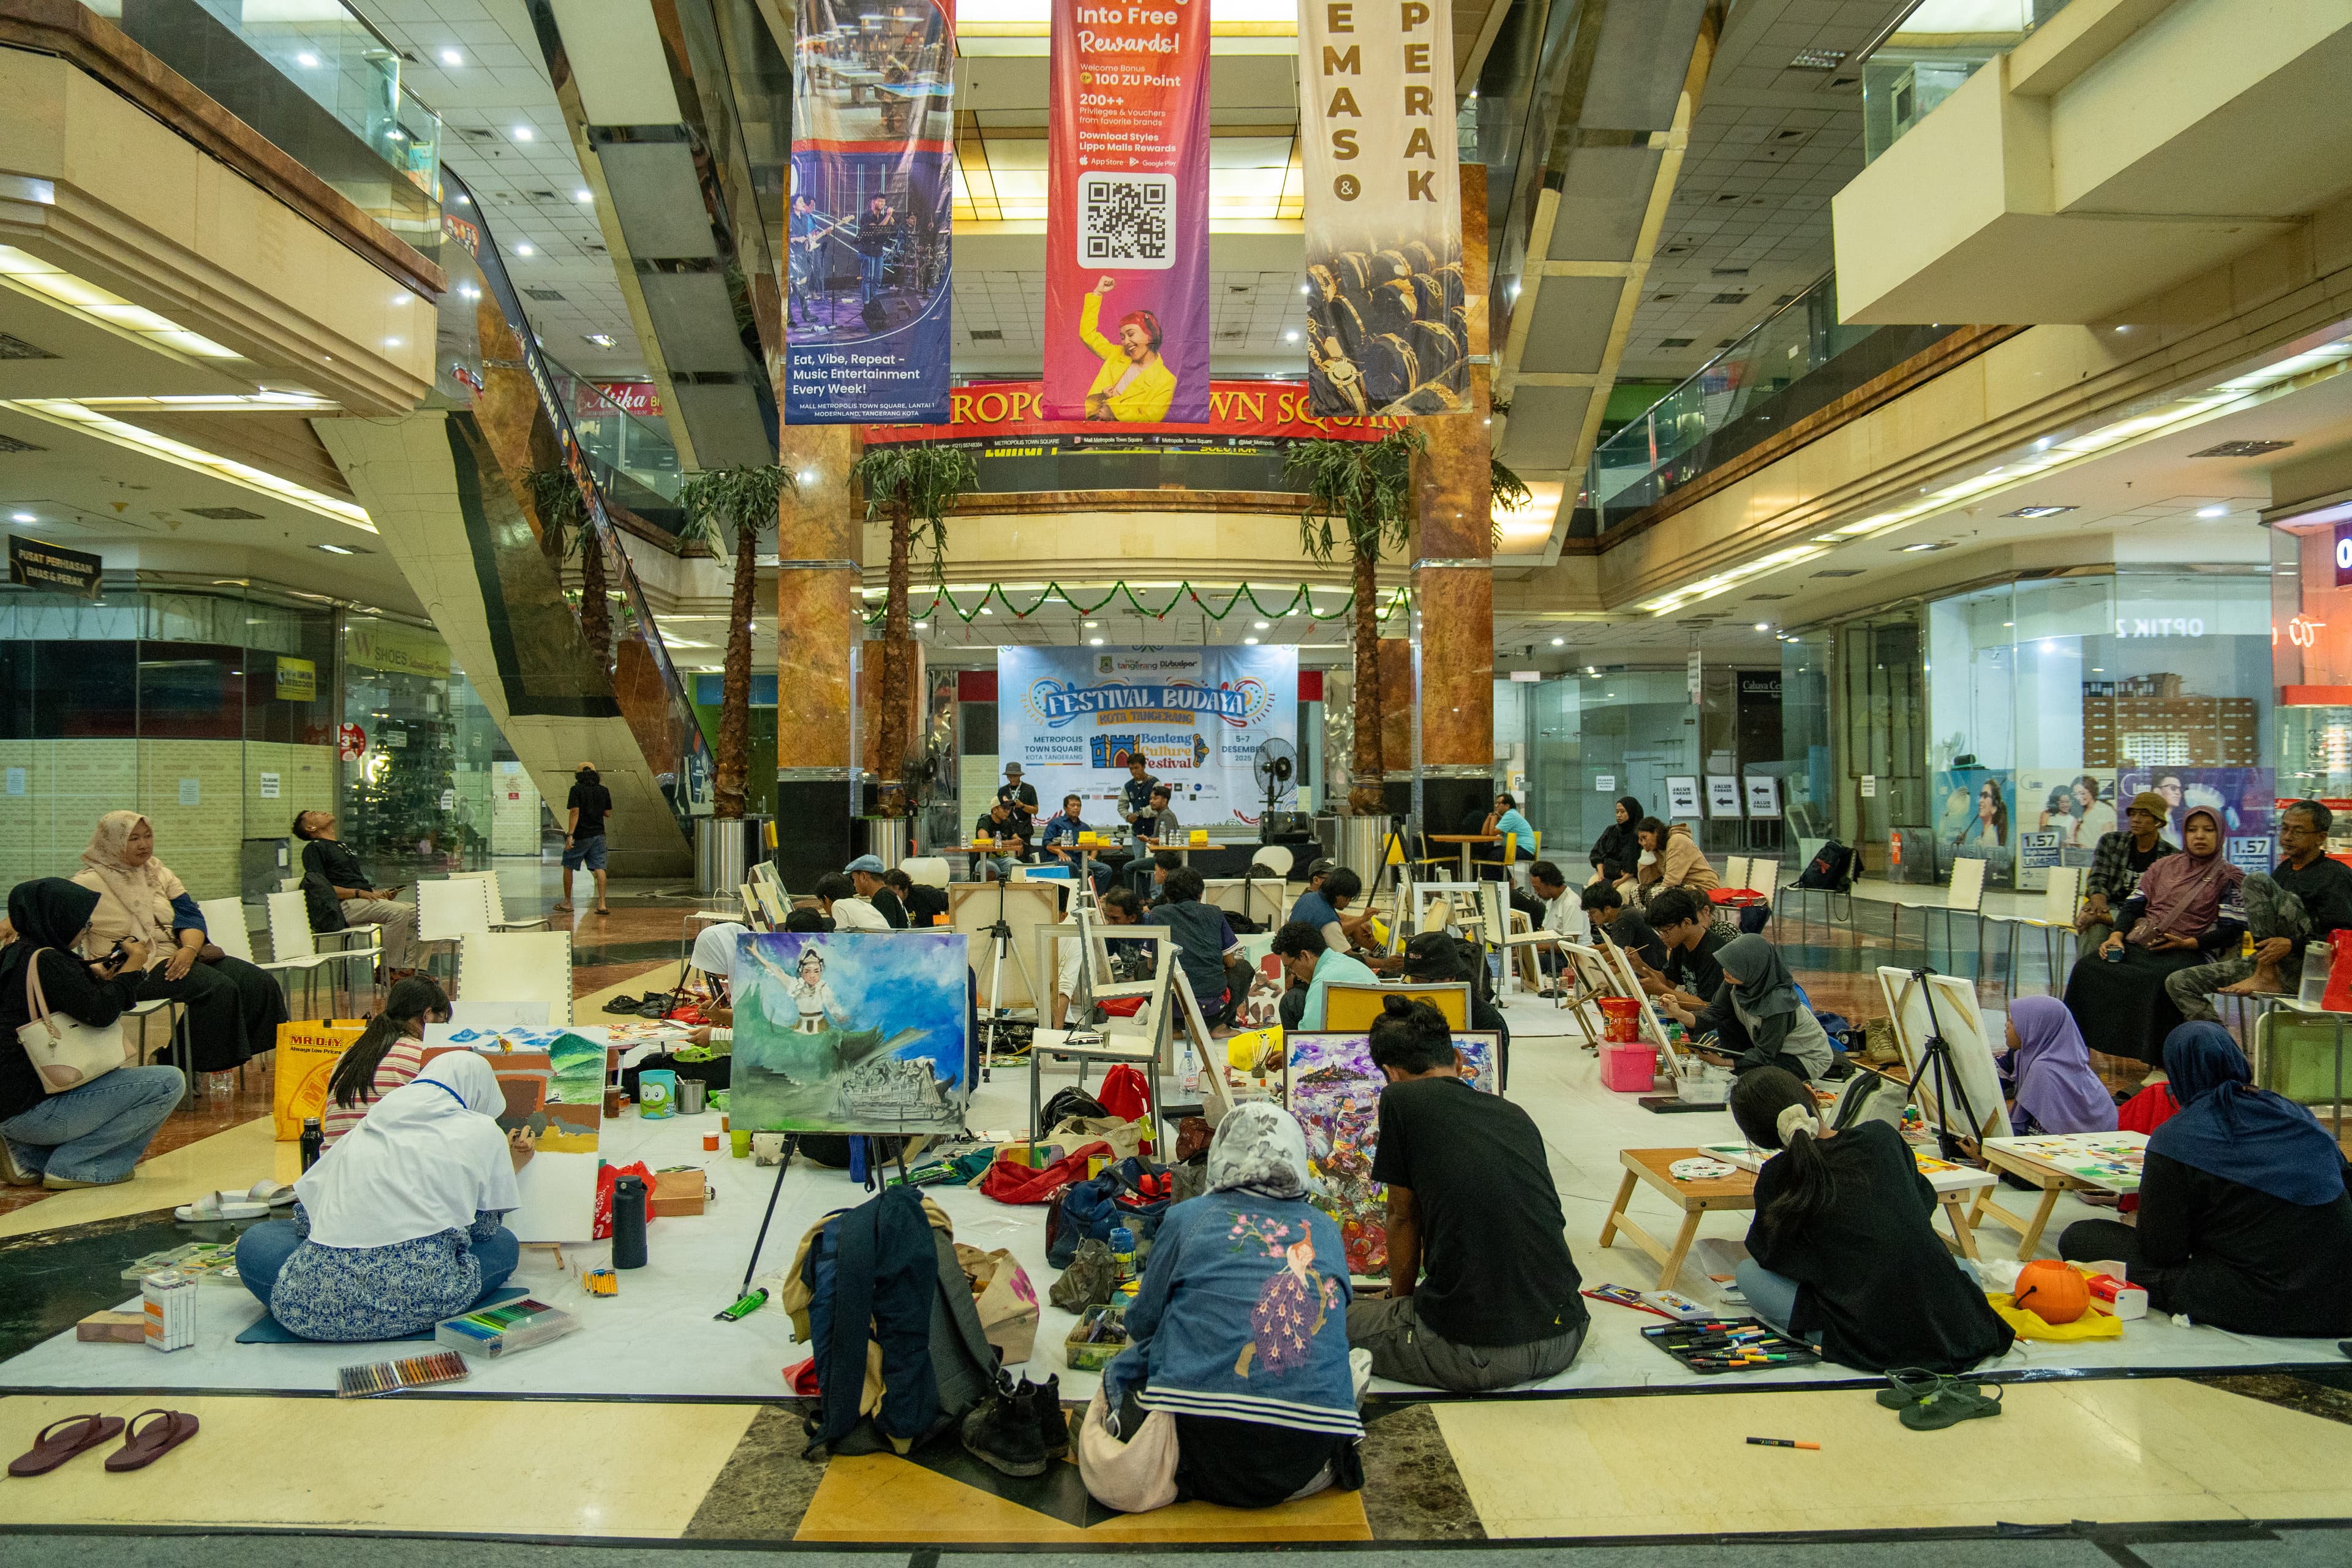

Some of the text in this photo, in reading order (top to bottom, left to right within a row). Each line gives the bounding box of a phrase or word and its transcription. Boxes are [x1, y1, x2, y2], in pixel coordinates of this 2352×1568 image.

[1077, 6, 1178, 25] Into Free
[1077, 31, 1179, 53] Rewards!
[1095, 74, 1181, 86] 100 ZU Point
[1080, 94, 1124, 105] 200++
[1401, 2, 1438, 202] PERAK
[1080, 107, 1117, 117] Privileges
[1080, 132, 1159, 143] Download Styles
[1080, 141, 1105, 152] Lippo
[794, 355, 815, 366] Eat,
[818, 353, 848, 365] Vibe,
[851, 353, 895, 366] Repeat
[793, 369, 920, 380] Music Entertainment
[528, 352, 558, 430] DARUMA
[793, 384, 866, 397] Every Week!
[18, 549, 45, 564] PUSAT
[57, 573, 85, 587] PERAK
[375, 647, 407, 666] SHOES
[1118, 662, 1157, 671] tangerang
[1048, 688, 1243, 715] FESTIVAL BUDAYA
[1099, 711, 1193, 724] KOTA TANGERANG
[1141, 733, 1193, 745] Benteng
[1140, 745, 1191, 756] Culture
[1144, 758, 1191, 768] Festival
[2024, 835, 2056, 847] 1.57
[2234, 840, 2266, 853] 1.57
